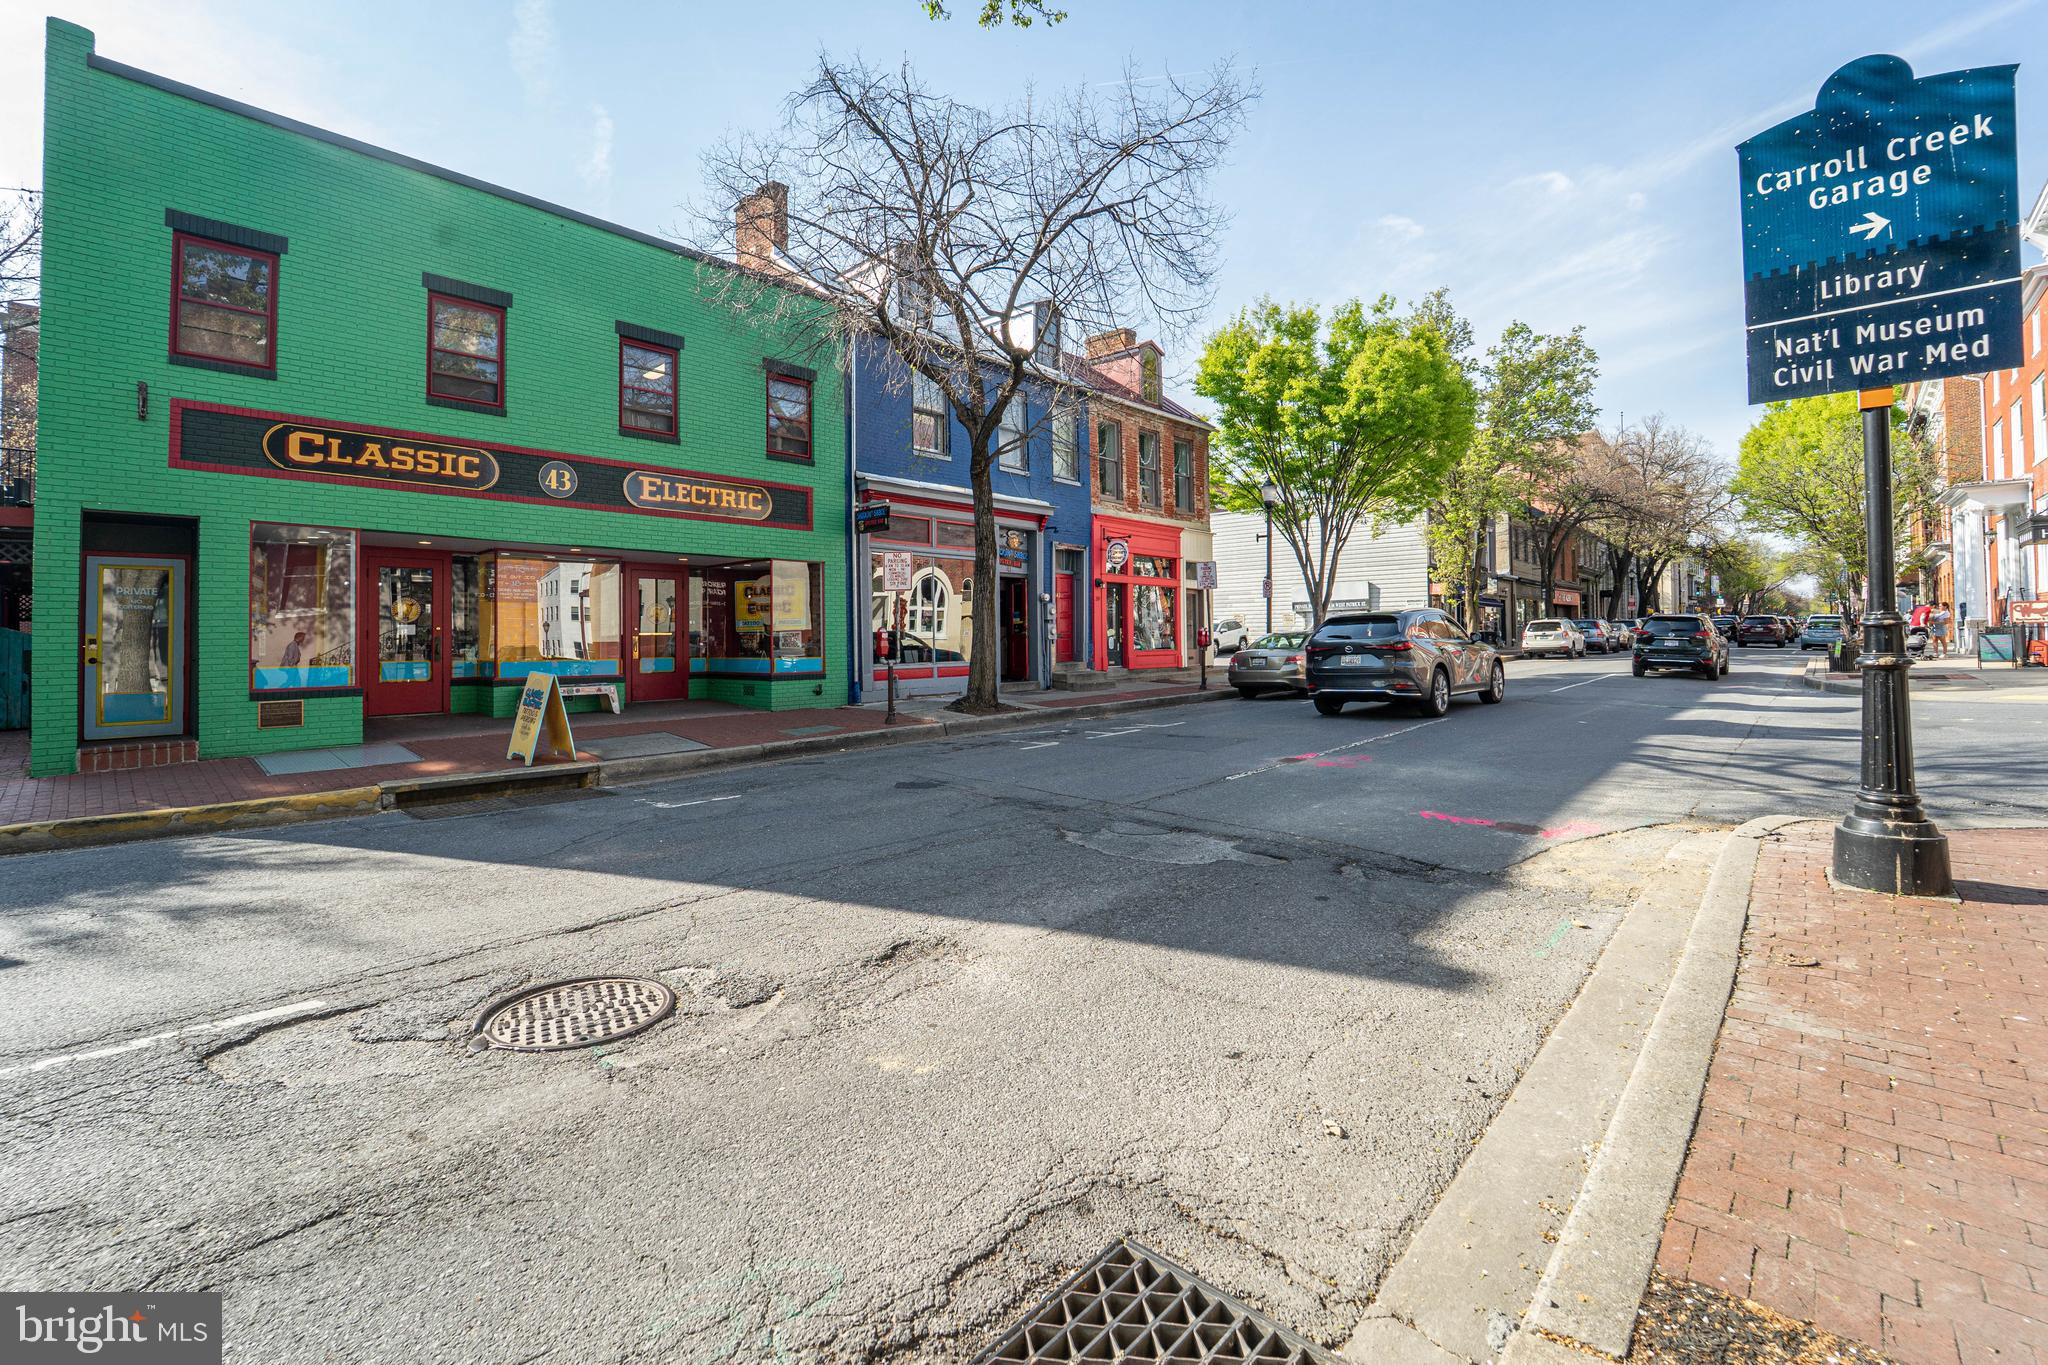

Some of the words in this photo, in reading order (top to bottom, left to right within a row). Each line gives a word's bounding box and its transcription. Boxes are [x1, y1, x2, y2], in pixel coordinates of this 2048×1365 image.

[1756, 146, 1867, 195] Carroll
[1887, 114, 1993, 162] Creek
[1809, 164, 1932, 210] Garage
[1821, 262, 1926, 300] Library
[1775, 329, 1840, 358] Nat'l
[1856, 308, 1984, 346] Museum
[1774, 357, 1834, 387] Civil
[1849, 348, 1913, 377] War
[1925, 334, 1990, 365] Med
[284, 431, 480, 479] CLASSIC
[545, 469, 571, 491] 43
[638, 476, 763, 511] ELECTRIC
[116, 587, 159, 596] PRIVATE
